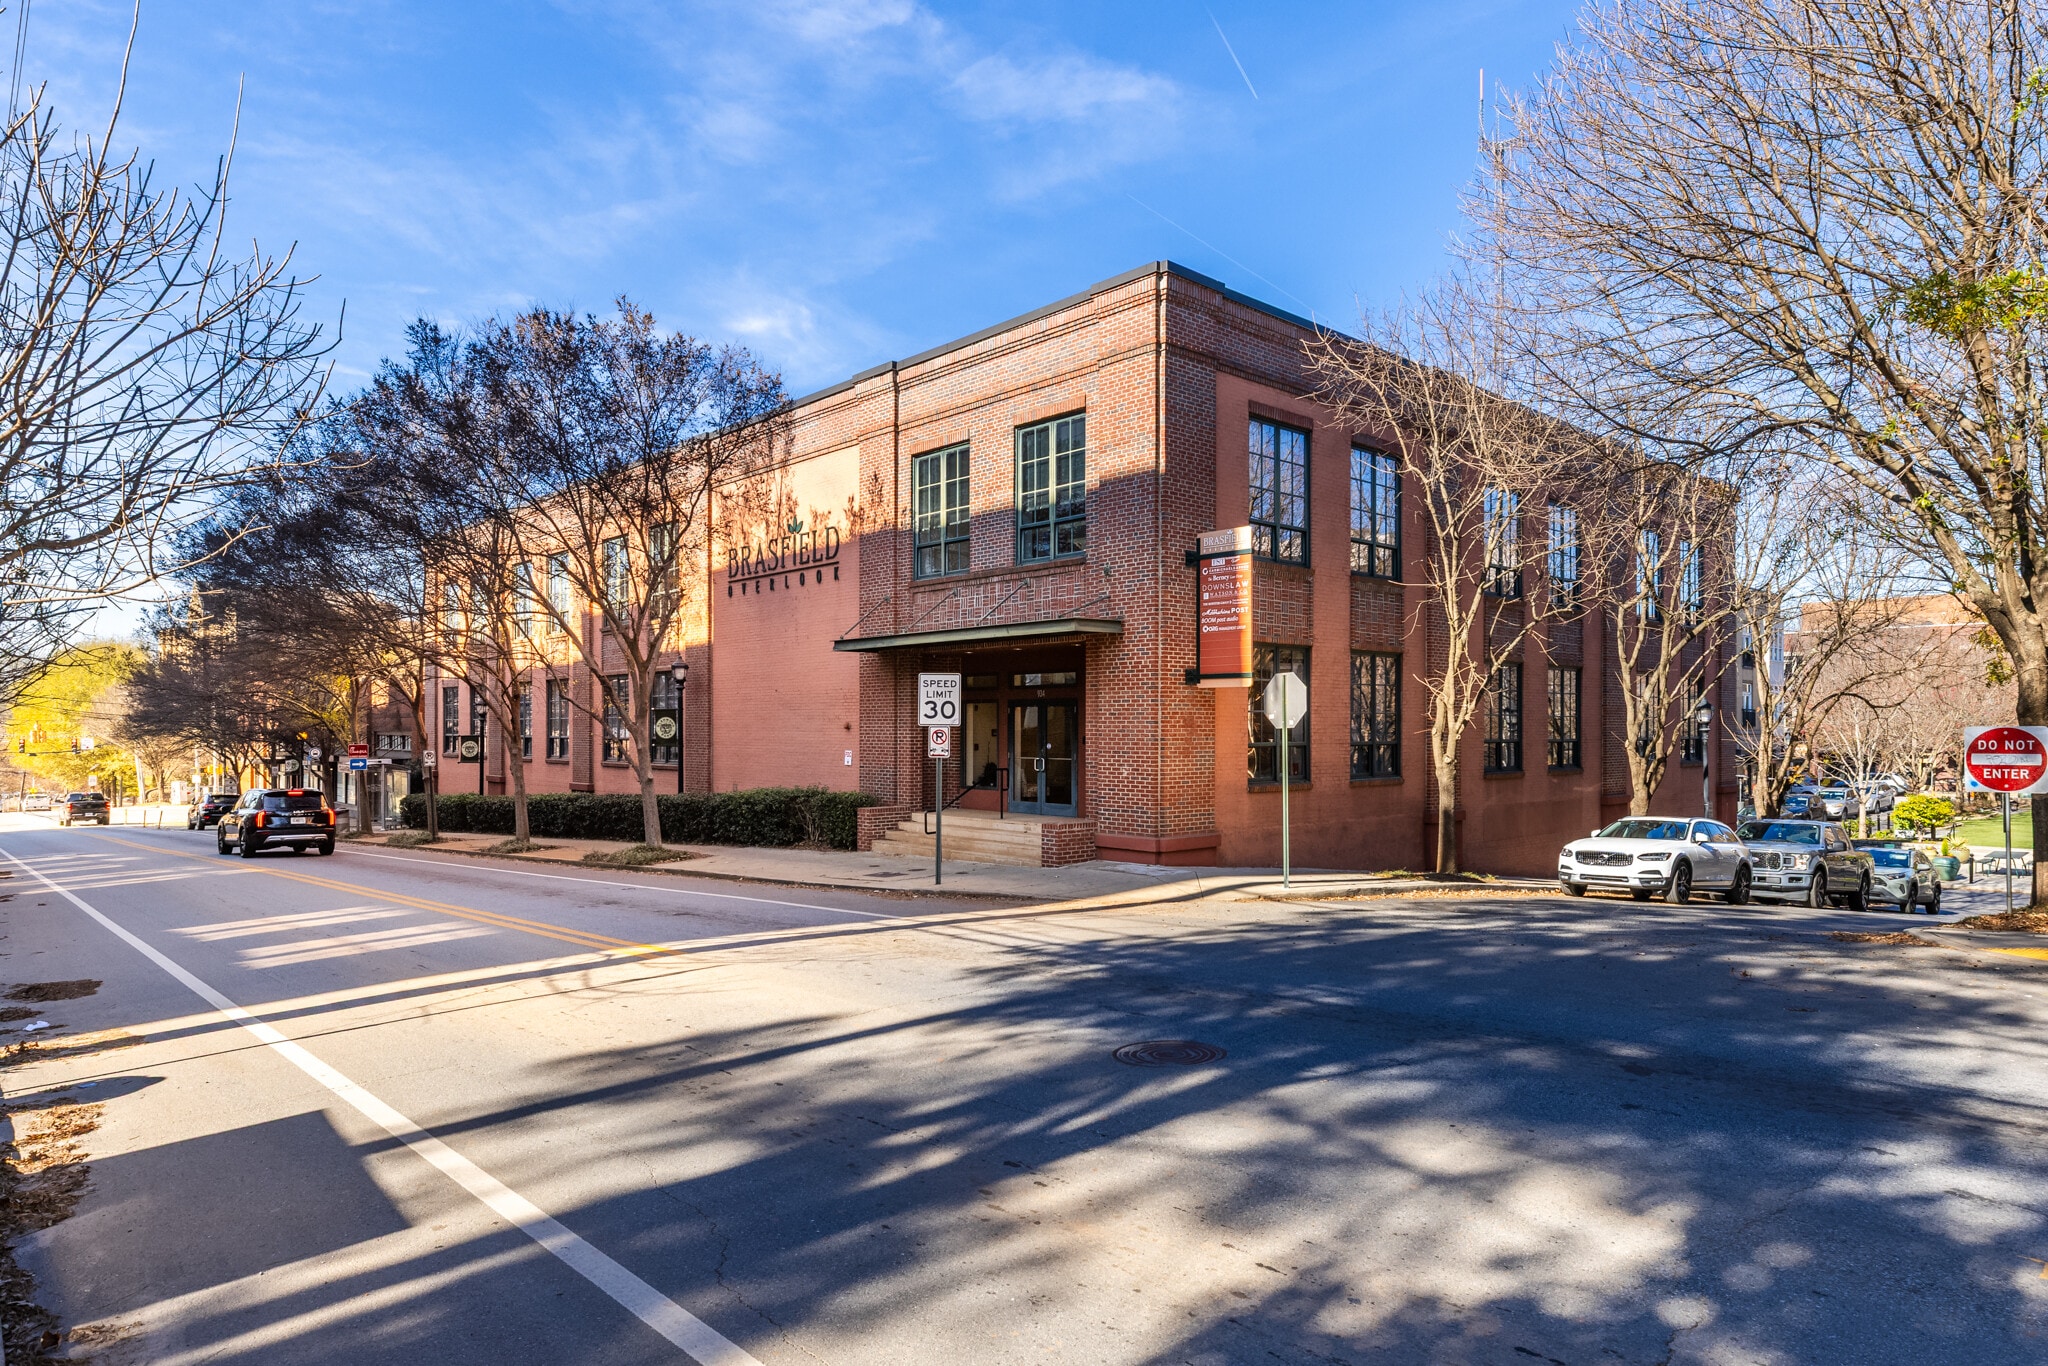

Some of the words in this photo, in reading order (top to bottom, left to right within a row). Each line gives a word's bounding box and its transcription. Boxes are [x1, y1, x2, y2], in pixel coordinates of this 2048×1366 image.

[1203, 532, 1247, 546] BRASFIEL
[728, 526, 840, 579] BRASFIELD
[728, 566, 840, 598] OVERLOOK
[922, 679, 957, 688] SPEED
[926, 690, 953, 698] LIMIT
[923, 700, 956, 719] 30
[1977, 739, 1998, 750] DO
[2004, 739, 2035, 750] NOT
[1983, 768, 2030, 779] ENTER
